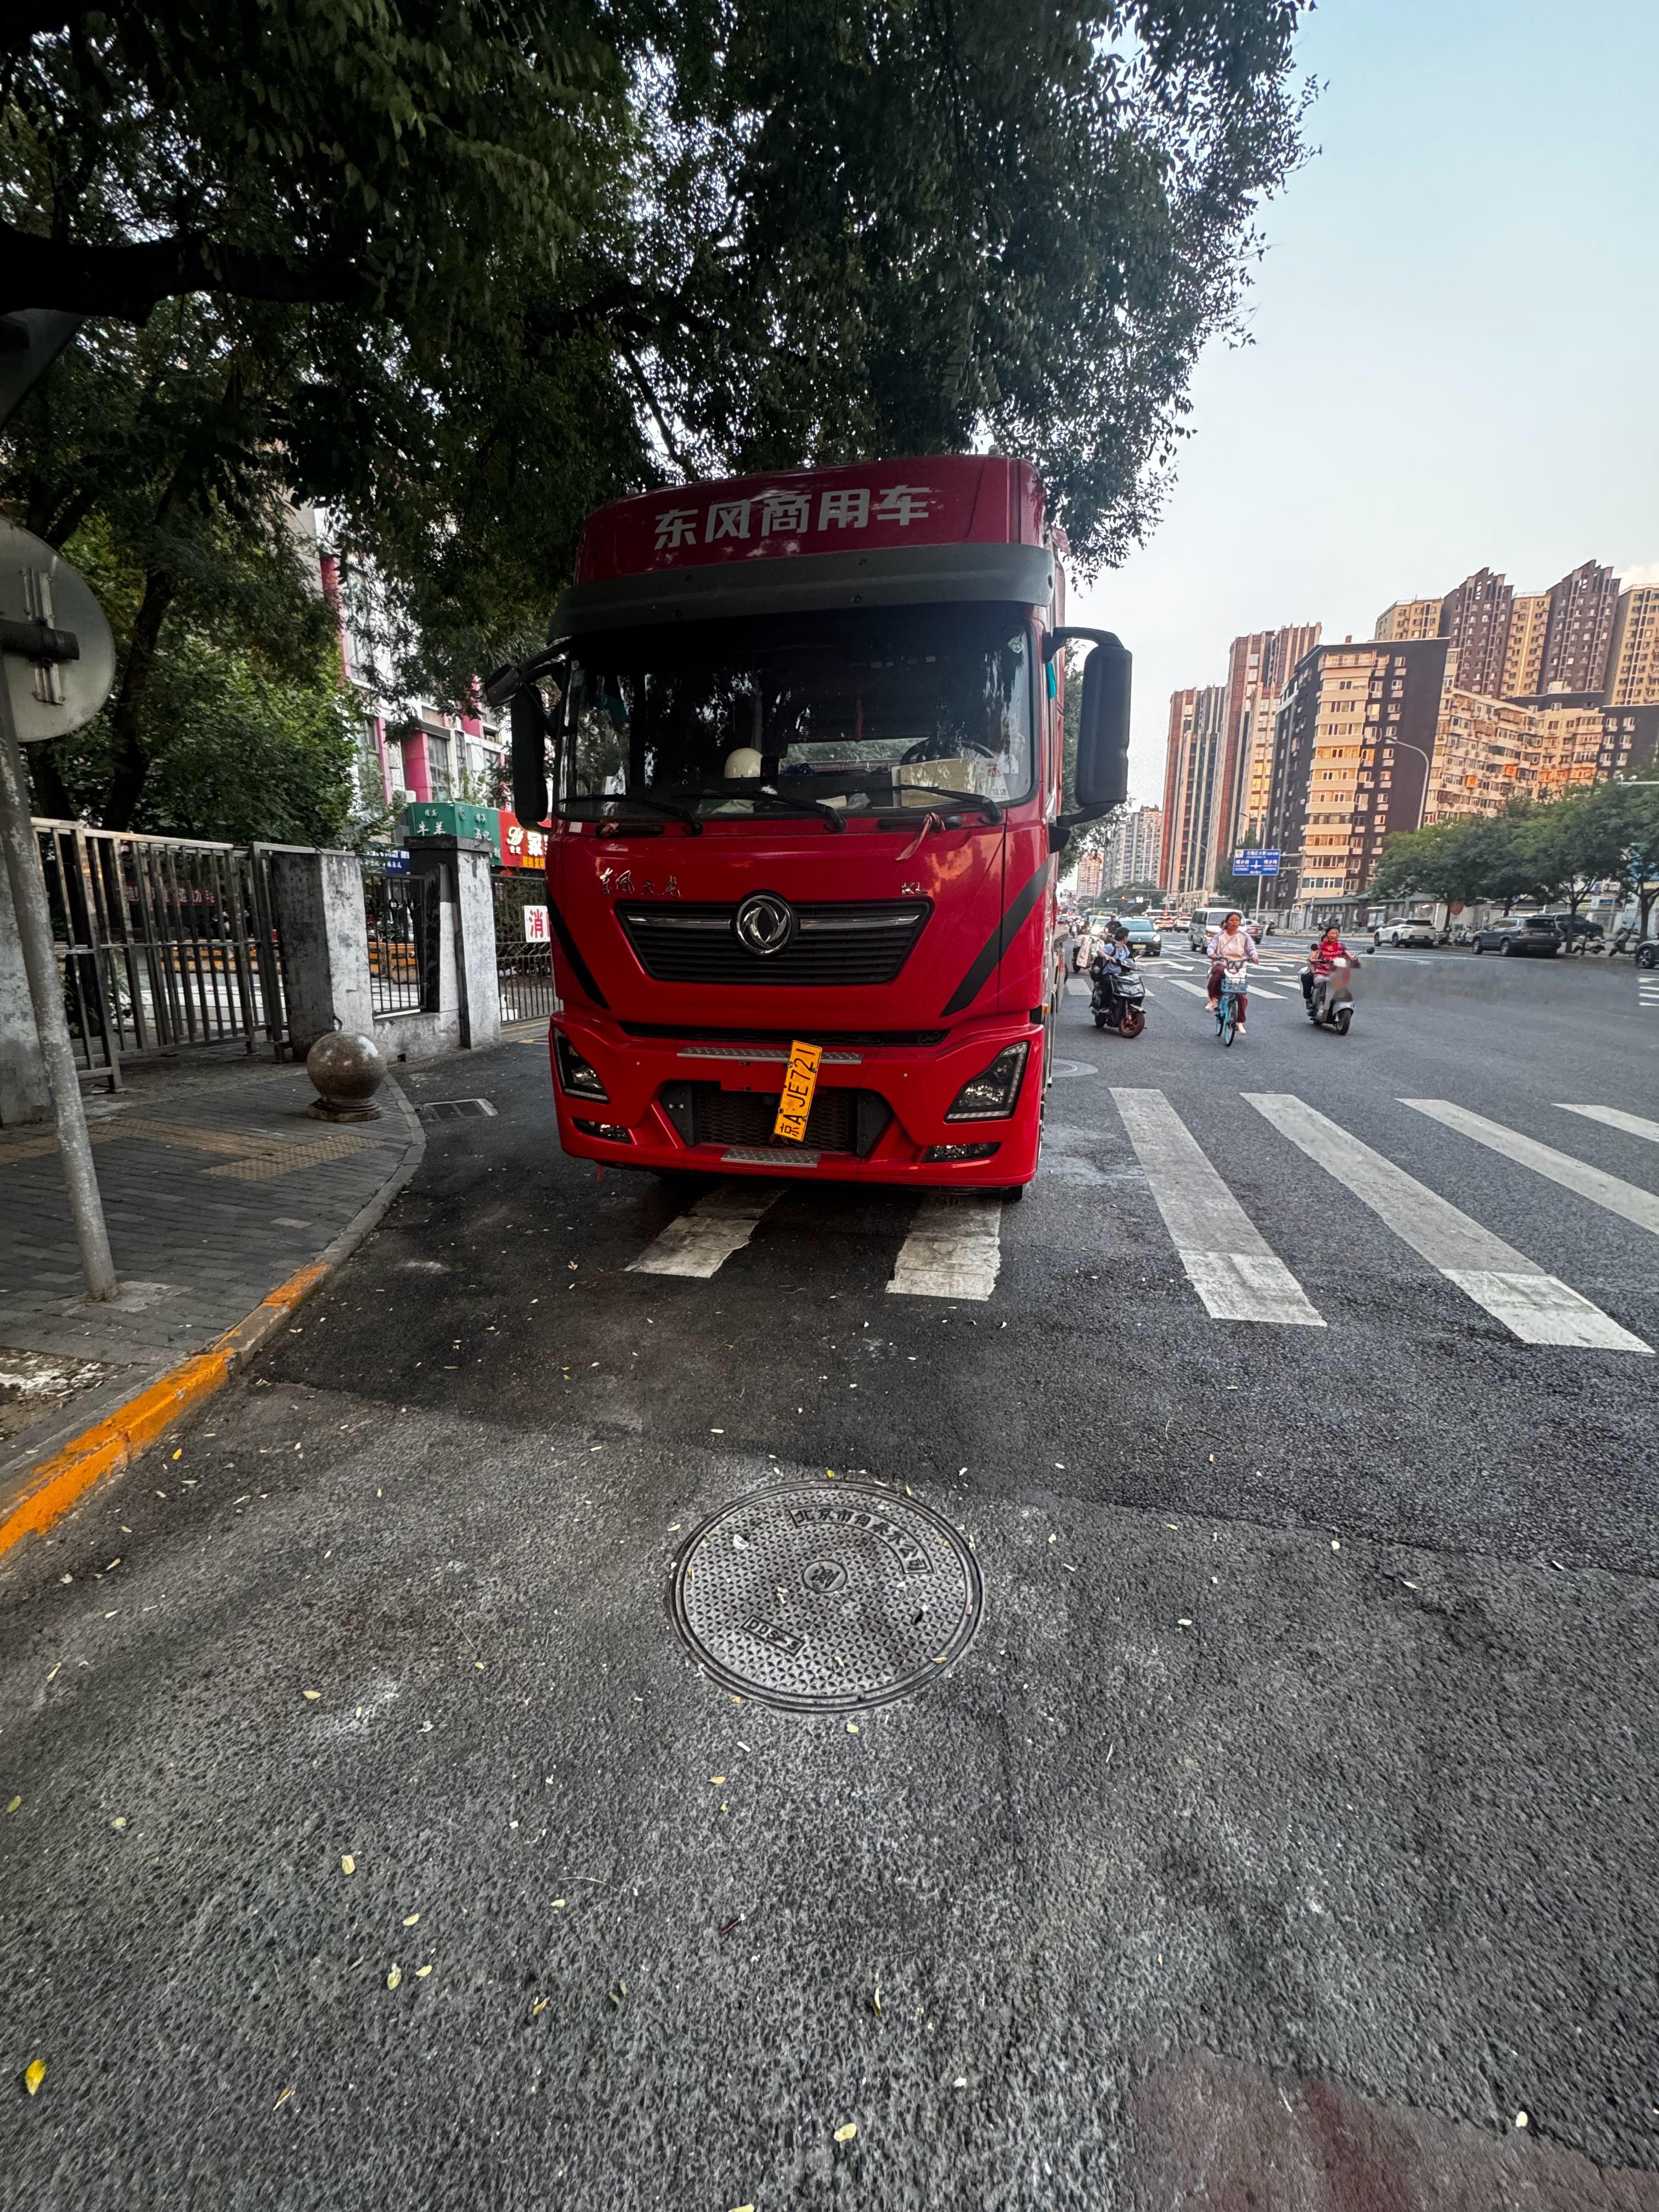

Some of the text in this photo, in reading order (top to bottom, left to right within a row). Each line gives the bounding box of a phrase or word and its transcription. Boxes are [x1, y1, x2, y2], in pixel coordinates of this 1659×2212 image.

[654, 485, 930, 550] 东风商用车
[901, 882, 928, 896] KL
[528, 909, 550, 938] 消
[794, 1508, 929, 1571] 北京市自来水公司
